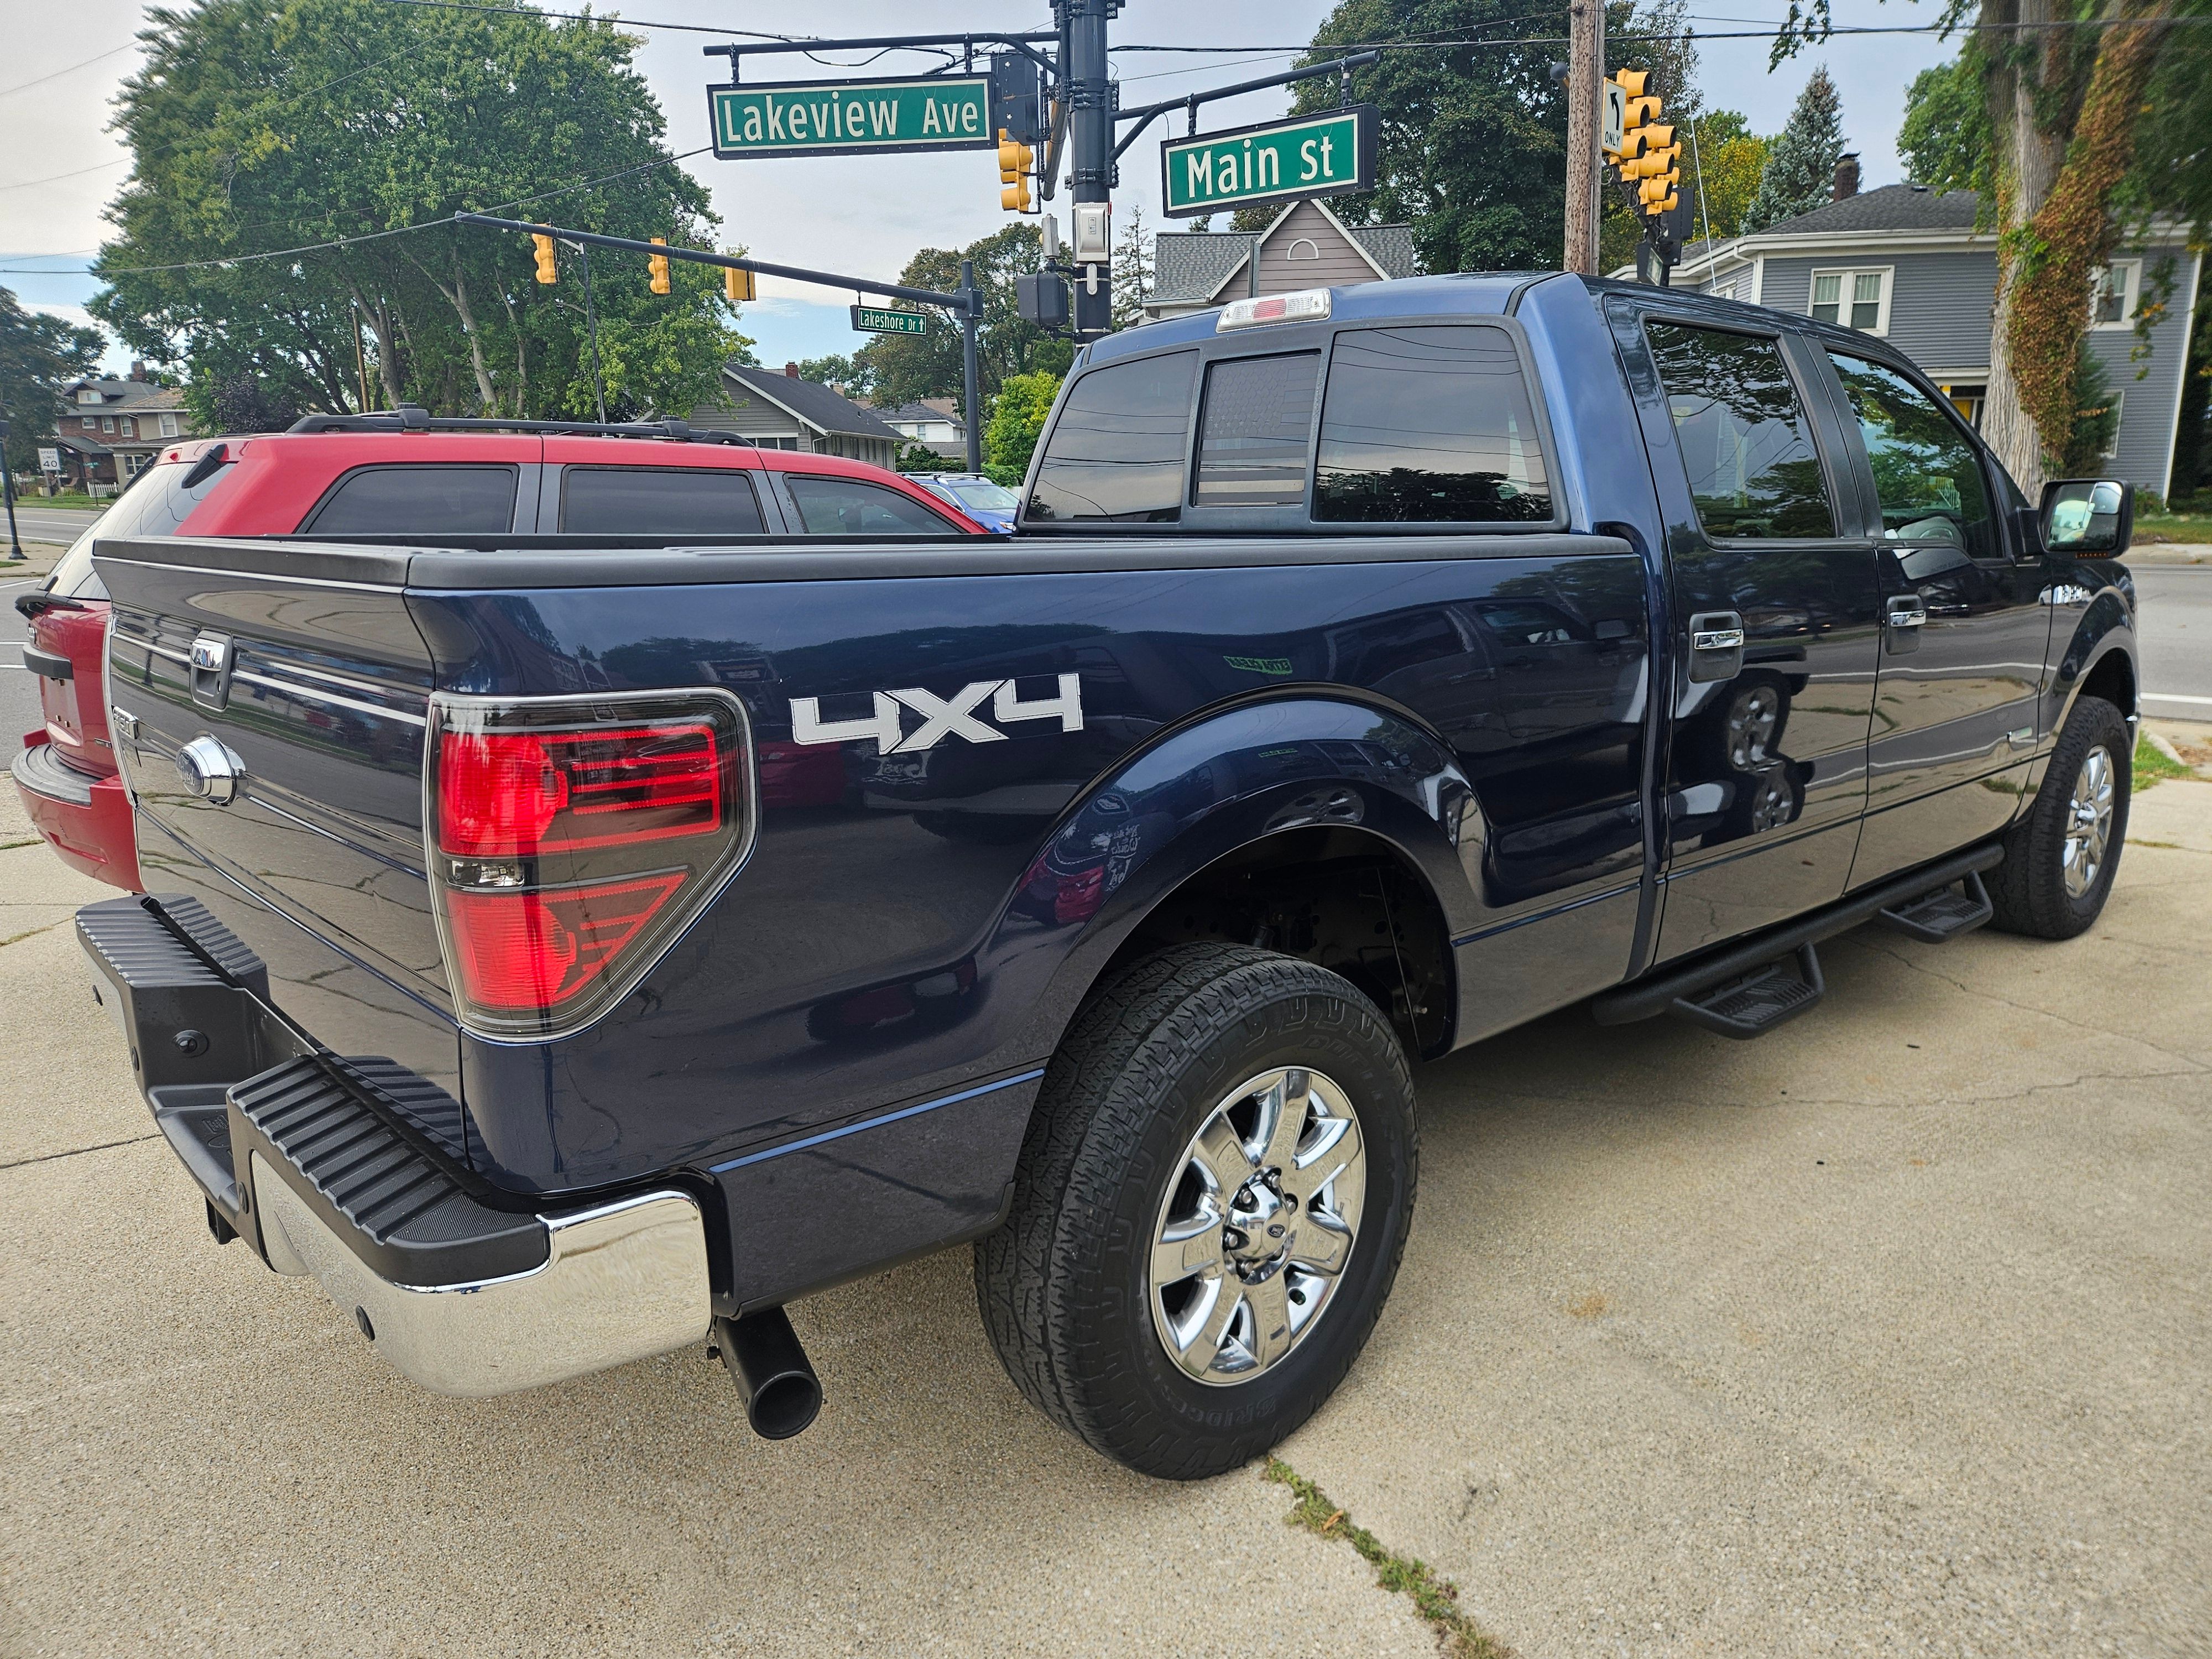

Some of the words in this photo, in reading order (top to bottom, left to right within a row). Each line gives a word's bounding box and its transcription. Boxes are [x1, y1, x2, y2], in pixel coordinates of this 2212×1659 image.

[724, 91, 898, 142] Lakeview
[922, 98, 978, 134] Ave
[1605, 131, 1620, 147] ONLY
[1188, 139, 1279, 197] Main
[1301, 136, 1333, 180] St
[860, 311, 904, 330] Lakeshore
[909, 319, 916, 331] Dr
[791, 672, 1083, 755] 4X4
